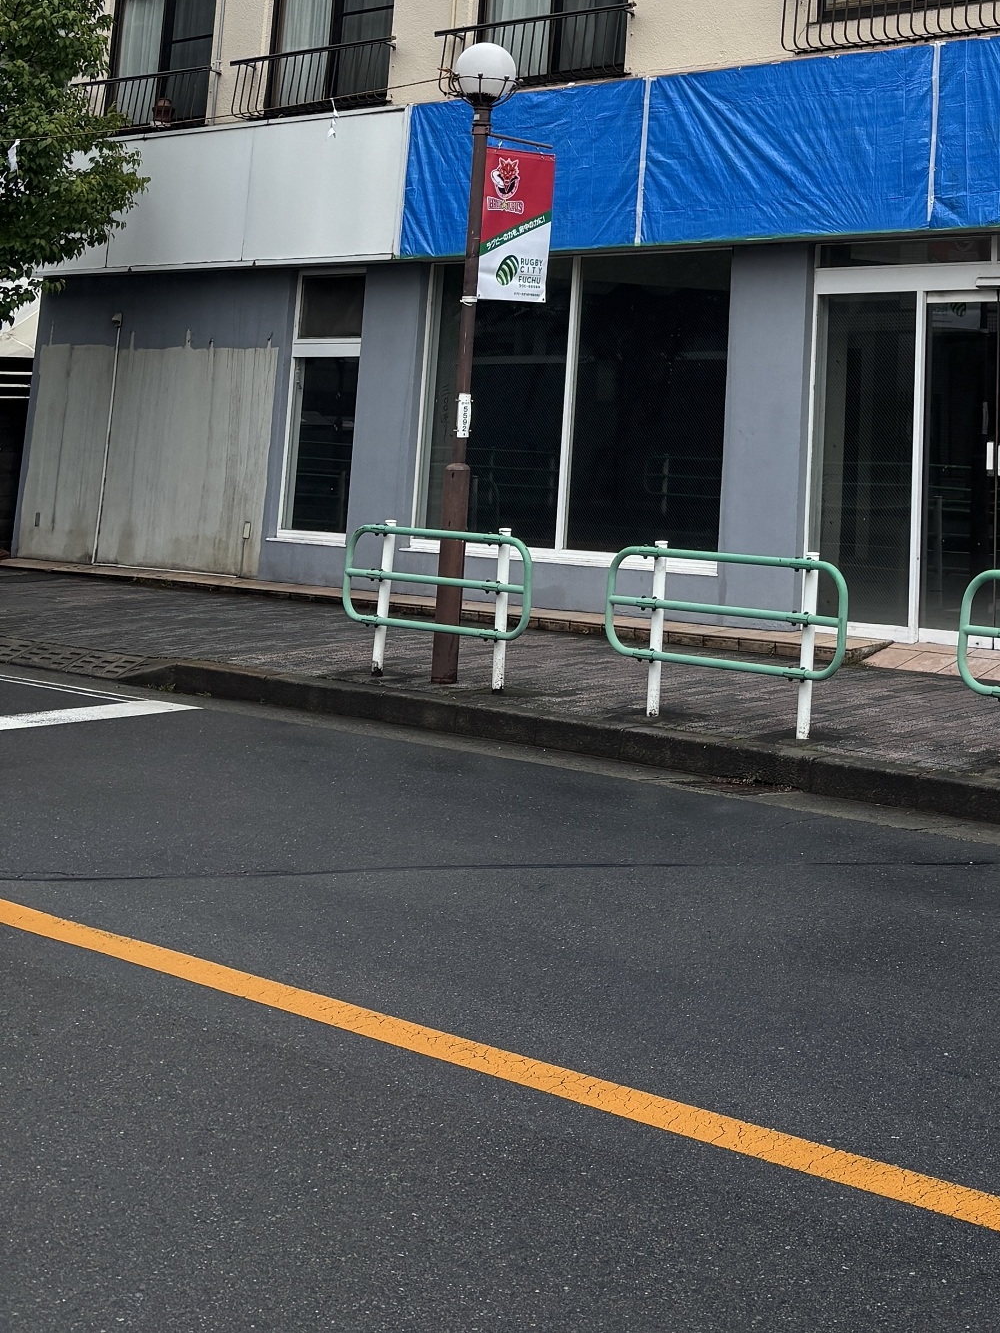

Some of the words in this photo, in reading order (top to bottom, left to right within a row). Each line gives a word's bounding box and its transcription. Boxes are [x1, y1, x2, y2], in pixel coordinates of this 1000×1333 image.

[520, 257, 543, 267] RUGBY
[519, 266, 543, 275] CITY
[518, 275, 541, 285] FUCHU
